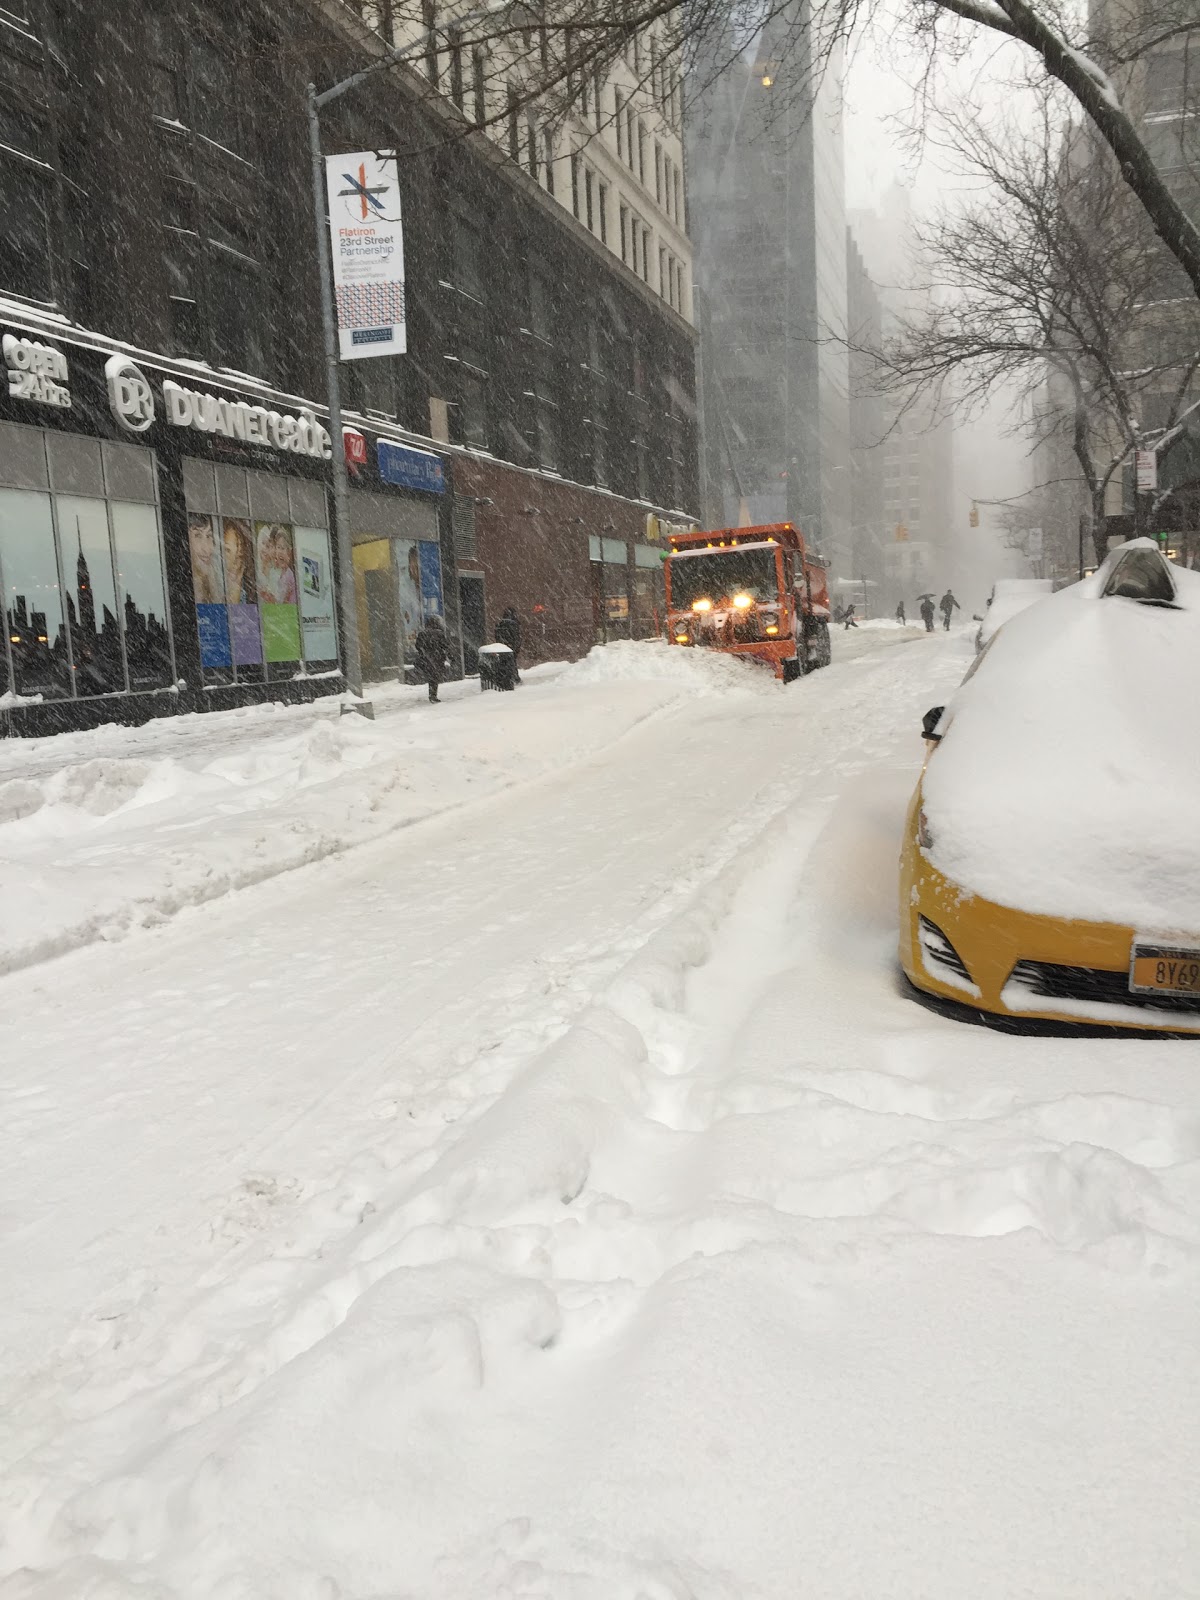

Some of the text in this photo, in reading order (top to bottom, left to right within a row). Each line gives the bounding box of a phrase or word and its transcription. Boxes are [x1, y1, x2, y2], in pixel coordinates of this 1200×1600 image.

[339, 228, 376, 237] Flatiron
[340, 235, 394, 247] 23rd Street
[340, 245, 395, 256] Partnership
[5, 340, 69, 381] OPEN
[163, 384, 333, 460] DUANEreade
[1155, 961, 1200, 986] 8Y69
